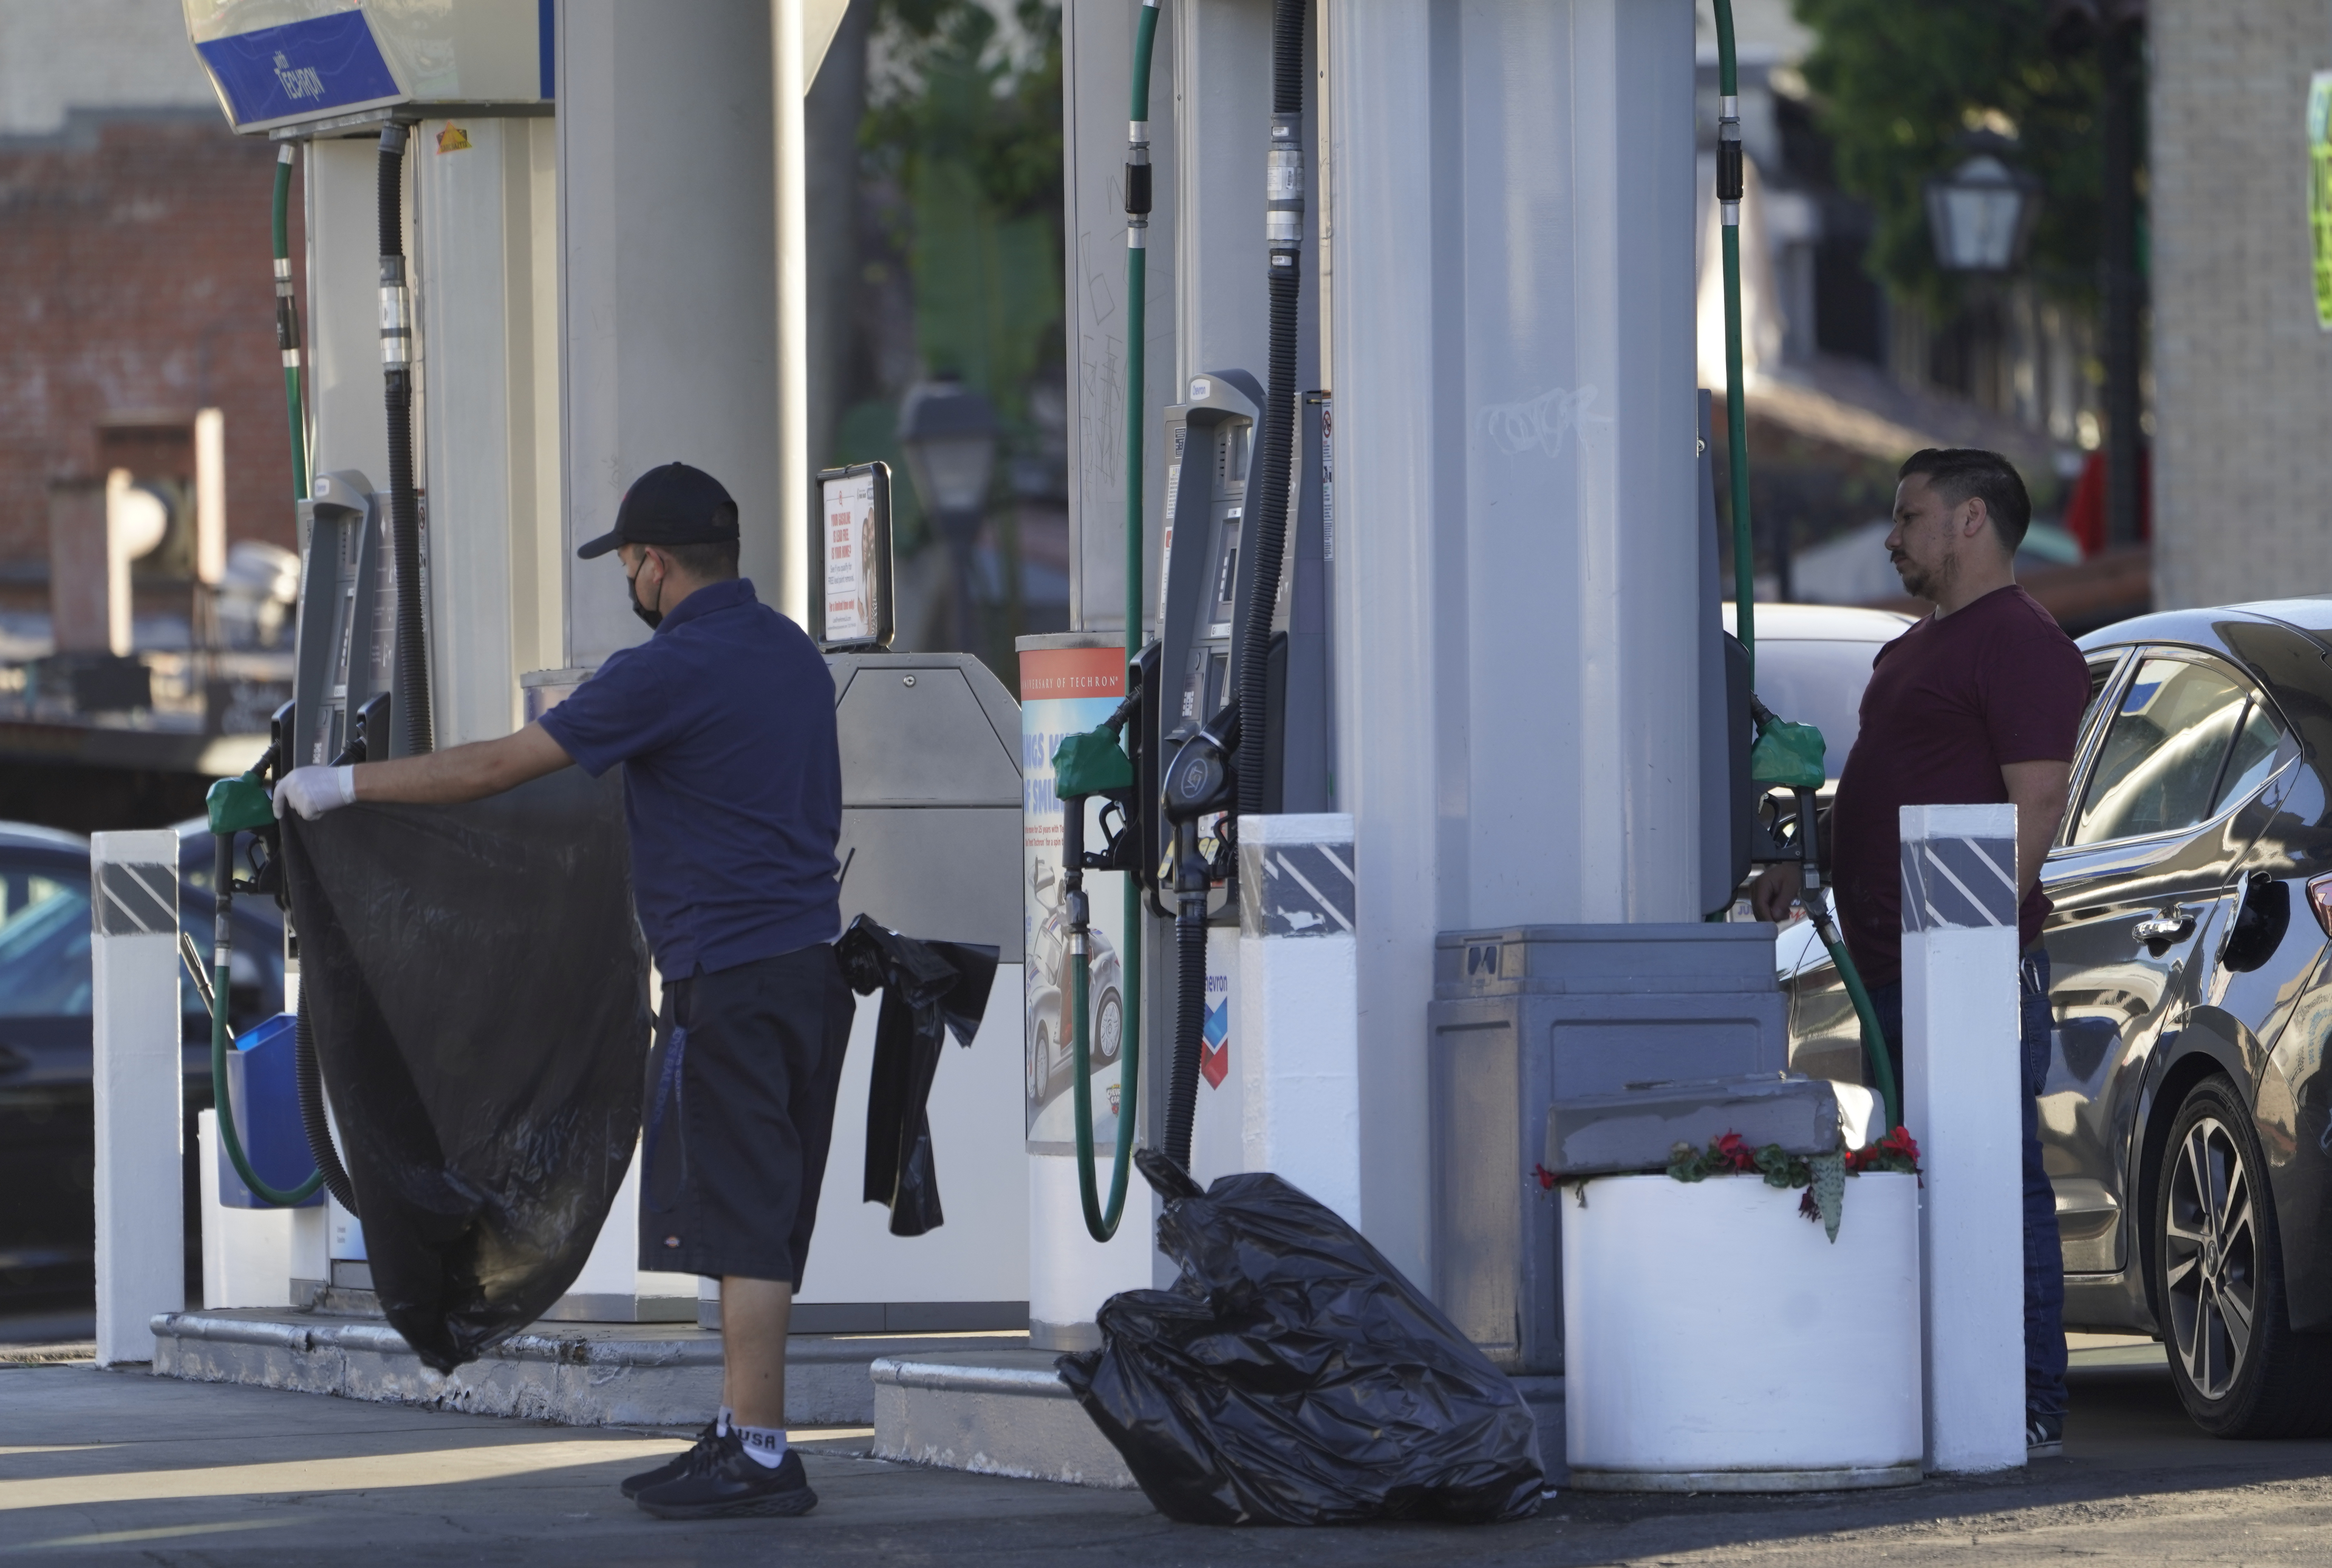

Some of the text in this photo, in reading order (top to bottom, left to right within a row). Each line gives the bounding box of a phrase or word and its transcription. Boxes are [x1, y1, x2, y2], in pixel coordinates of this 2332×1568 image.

[272, 50, 289, 69] with
[273, 67, 325, 102] TECHRON
[1192, 385, 1206, 395] Chevron
[838, 511, 851, 526] GASOLINE
[842, 544, 851, 558] HOME?
[1057, 677, 1065, 688] OF
[1023, 732, 1045, 770] INGS
[1038, 825, 1042, 833] 25
[1042, 826, 1051, 835] years
[1737, 905, 1753, 916] JU
[737, 1428, 776, 1450] USA
